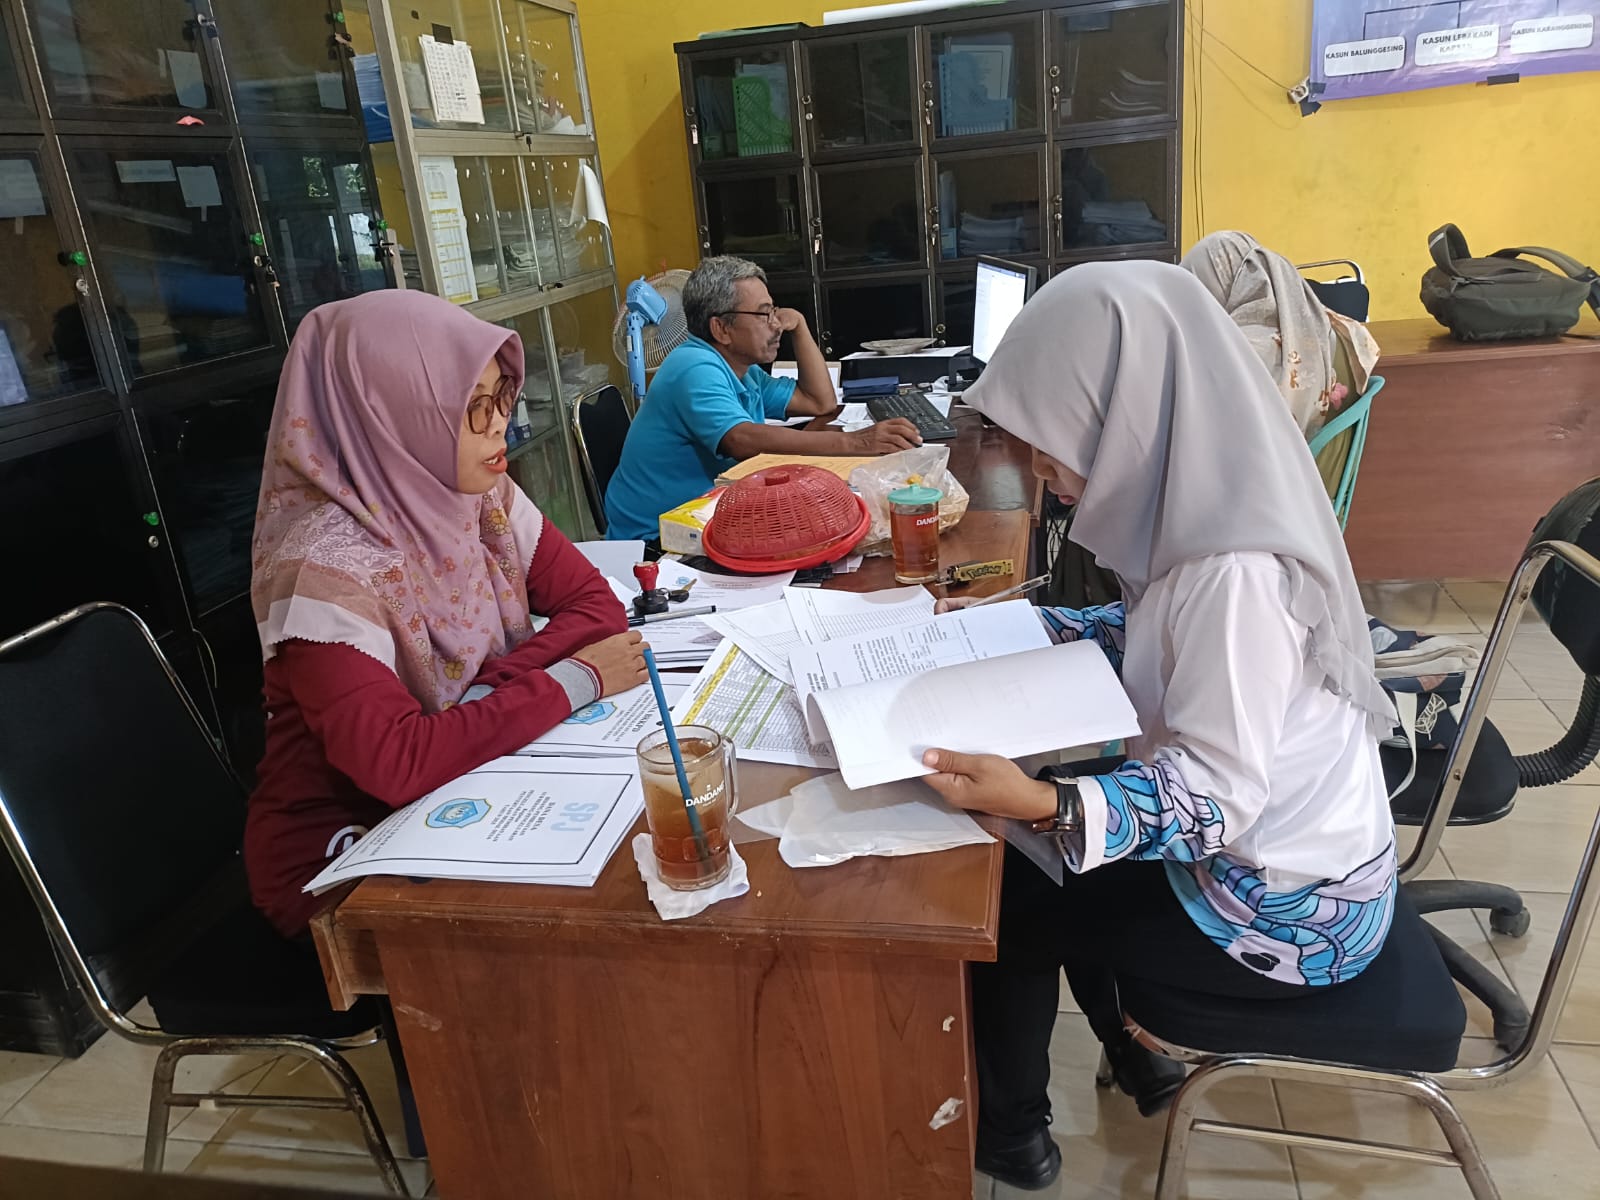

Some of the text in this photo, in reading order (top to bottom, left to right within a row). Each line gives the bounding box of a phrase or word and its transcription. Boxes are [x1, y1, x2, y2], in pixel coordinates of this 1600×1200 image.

[1422, 35, 1451, 45] KASUN
[1326, 45, 1404, 59] KASUN BALUNGGESING
[550, 802, 600, 832] SPJ
